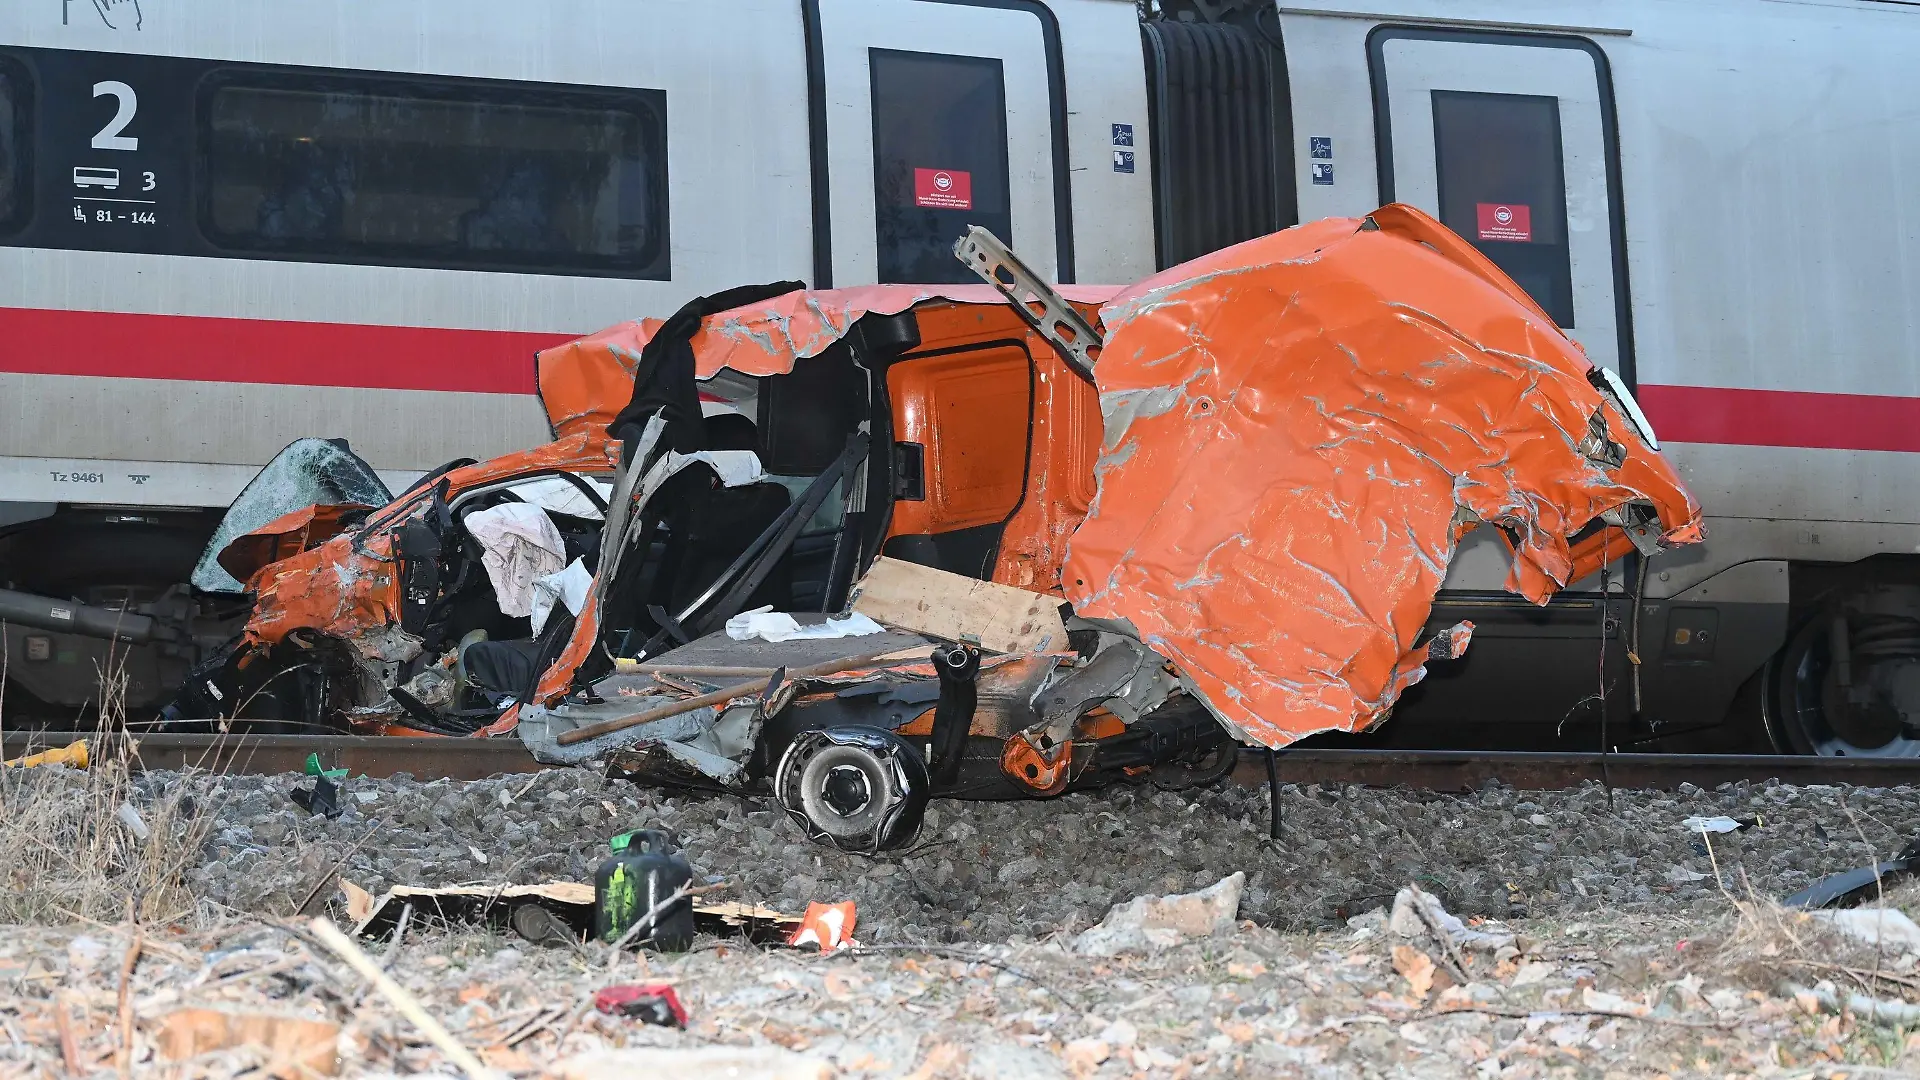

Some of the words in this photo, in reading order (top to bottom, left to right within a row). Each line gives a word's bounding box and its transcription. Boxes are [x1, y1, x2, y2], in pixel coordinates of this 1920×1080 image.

[91, 80, 139, 151] 2
[142, 171, 156, 191] 3
[96, 209, 113, 222] 81
[131, 211, 156, 225] 144
[50, 471, 68, 482] Tz
[71, 472, 104, 483] 9461
